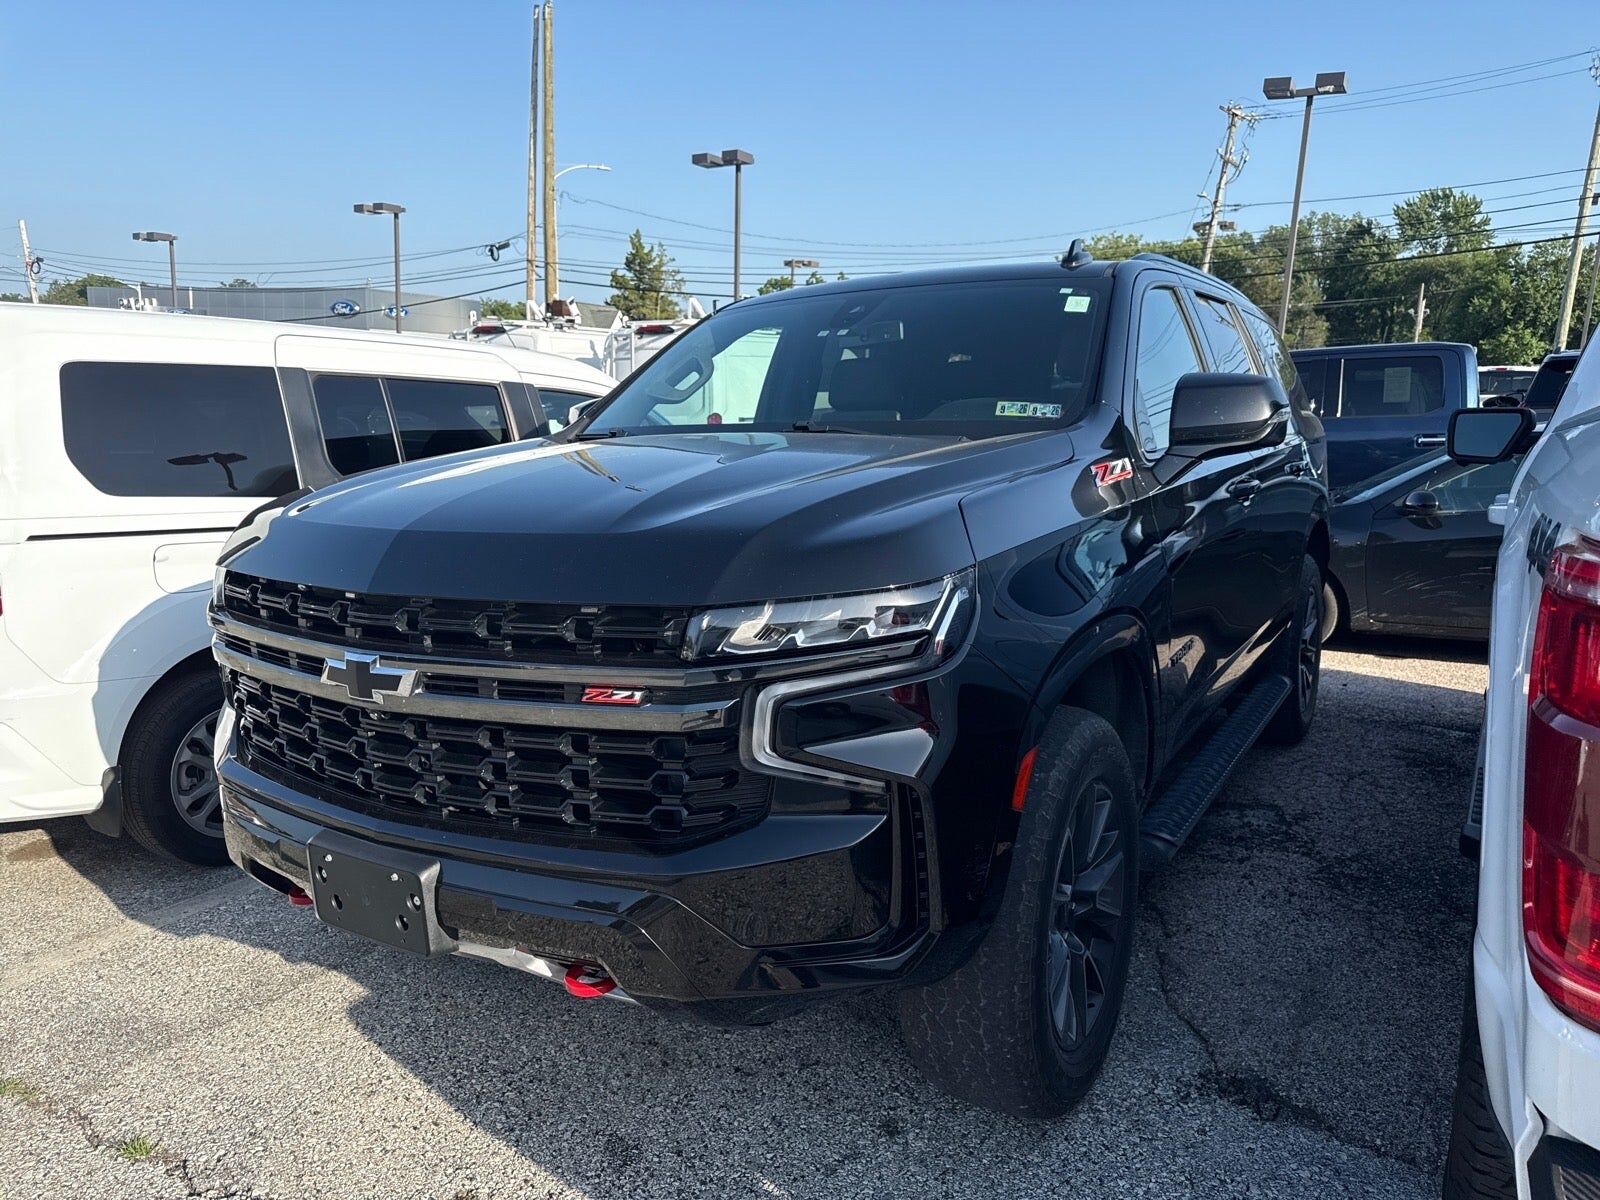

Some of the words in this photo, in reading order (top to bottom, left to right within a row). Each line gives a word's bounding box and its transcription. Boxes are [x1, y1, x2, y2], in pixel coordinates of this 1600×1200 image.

[334, 303, 353, 314] Ford
[999, 405, 1006, 414] 9
[1019, 404, 1028, 414] 26
[1032, 406, 1038, 415] 9
[1051, 406, 1060, 416] 26
[1090, 457, 1133, 487] Z71
[581, 688, 644, 704] Z71
